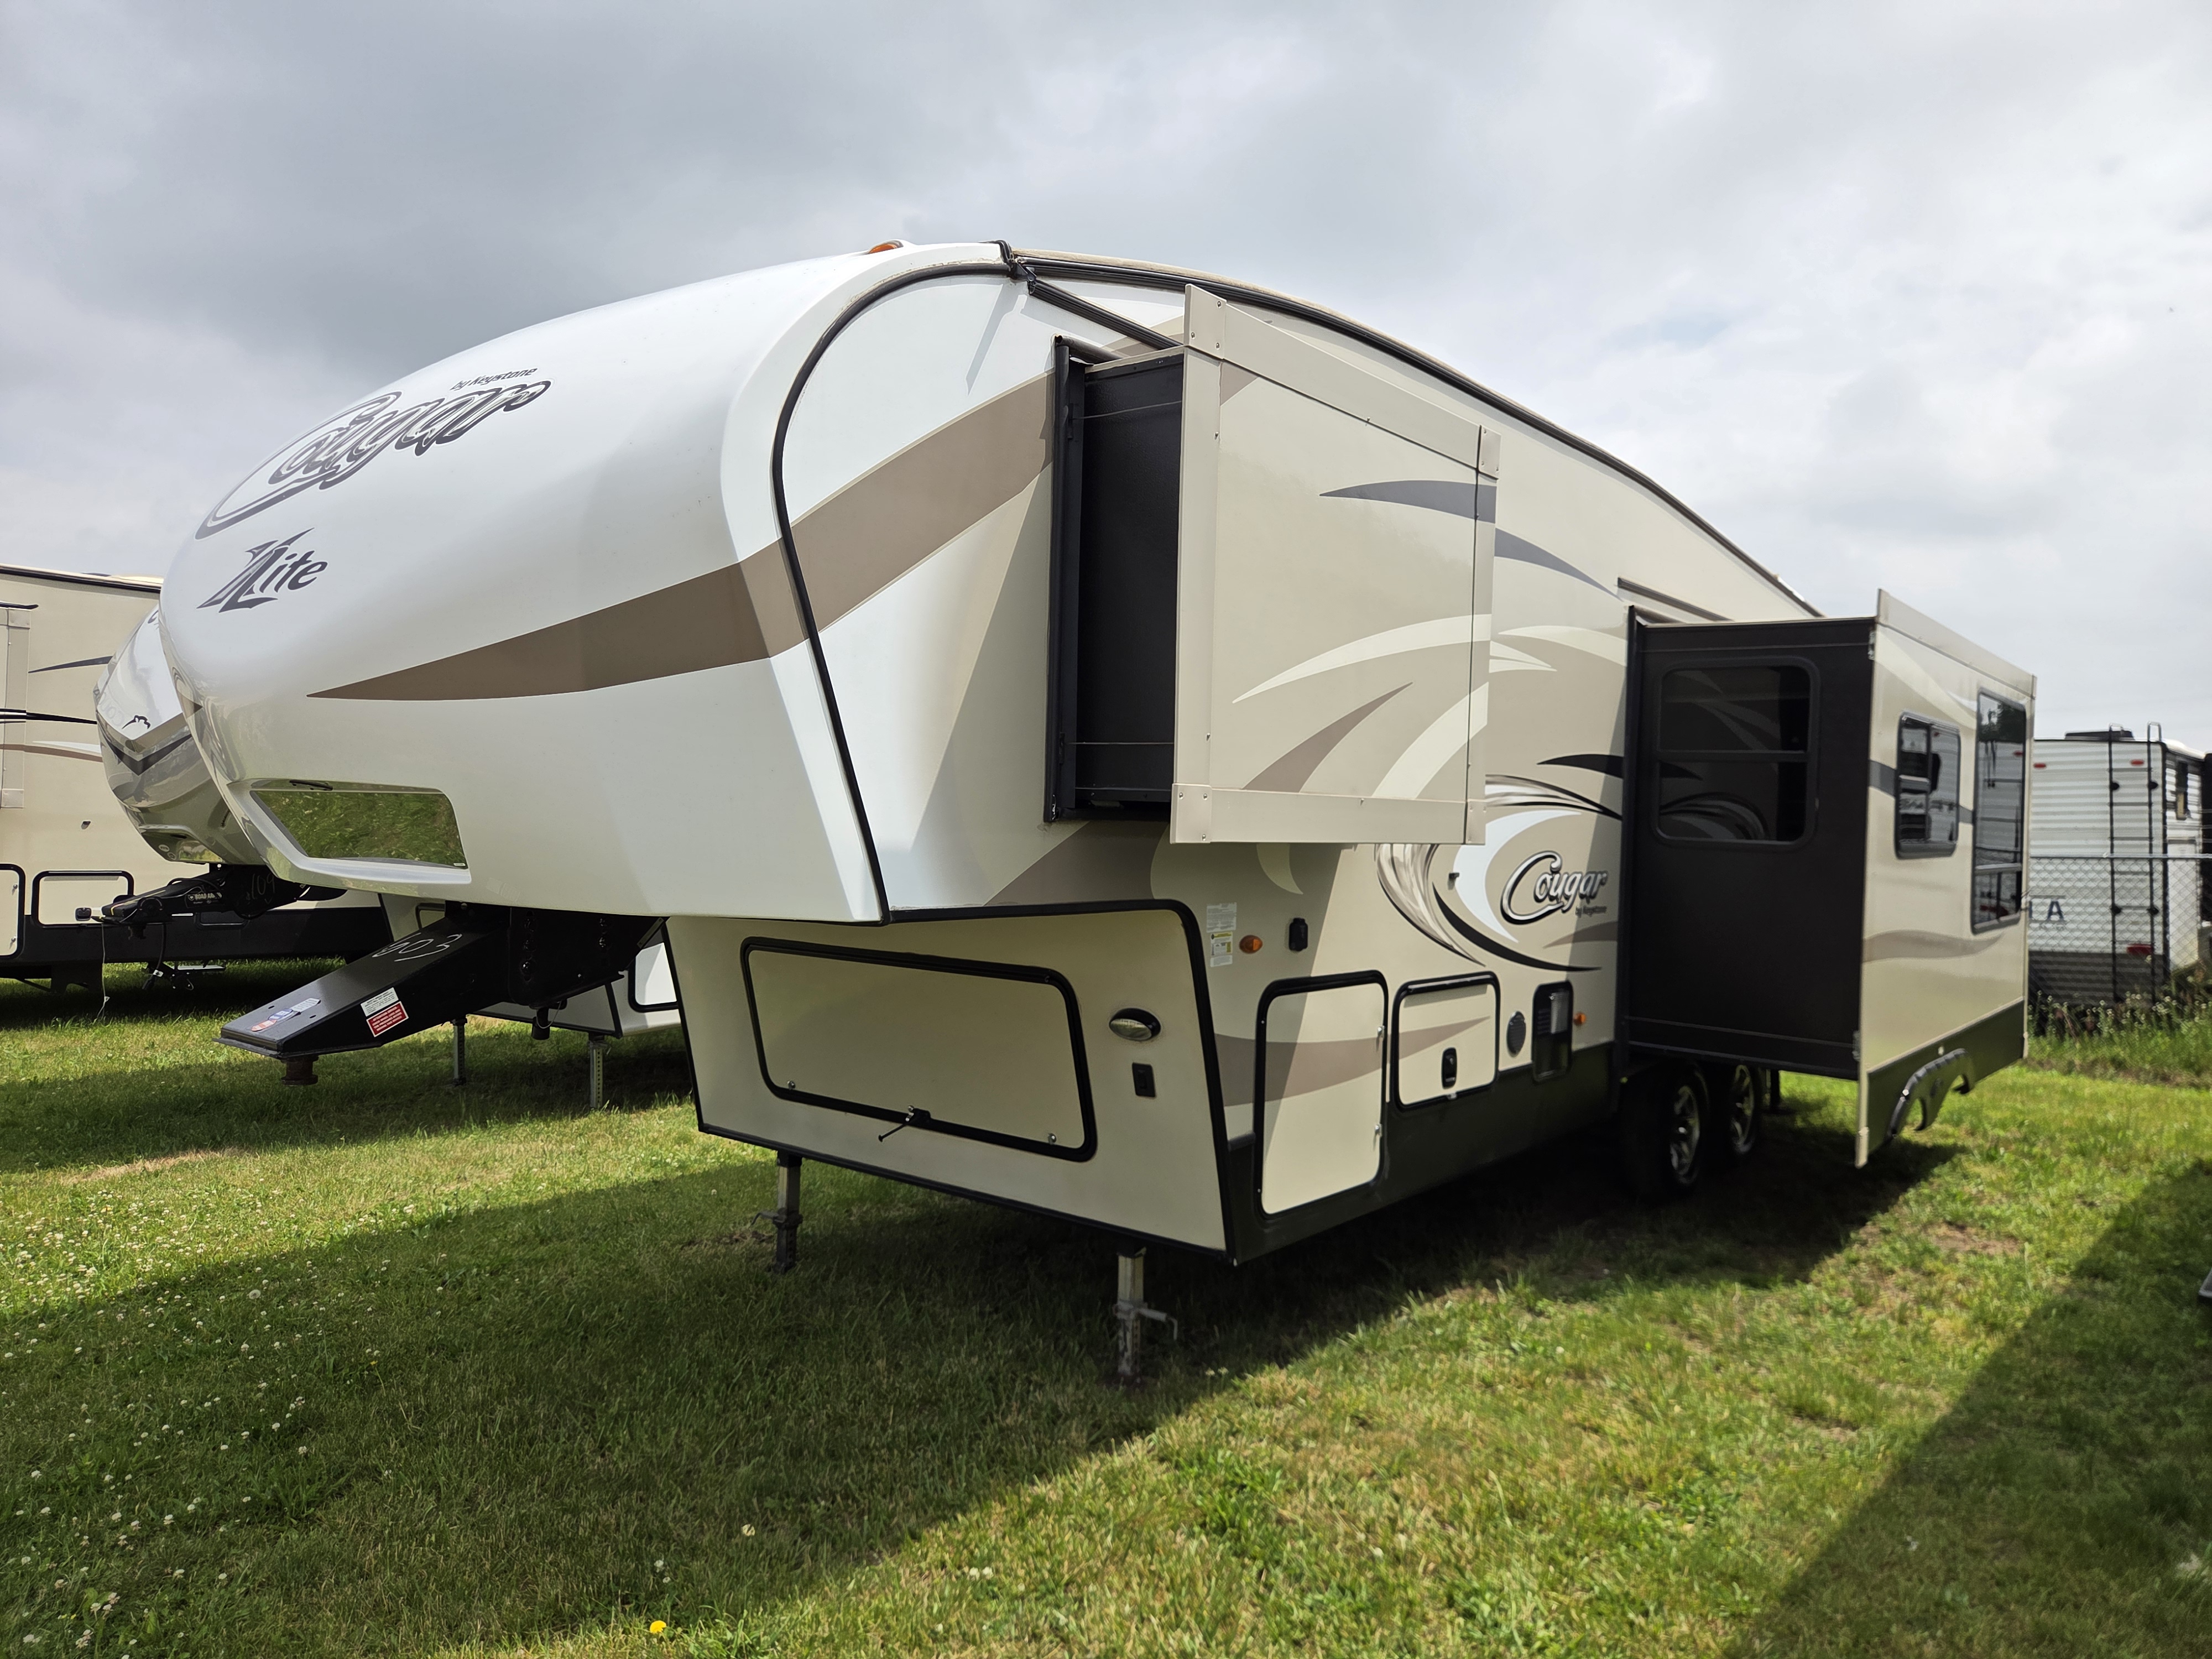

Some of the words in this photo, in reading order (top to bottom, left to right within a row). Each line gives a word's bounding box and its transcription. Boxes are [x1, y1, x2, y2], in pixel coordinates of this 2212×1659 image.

[450, 380, 469, 391] by
[468, 368, 538, 386] Keystone
[195, 379, 552, 540] Cougar
[1500, 850, 1609, 925] Cougar
